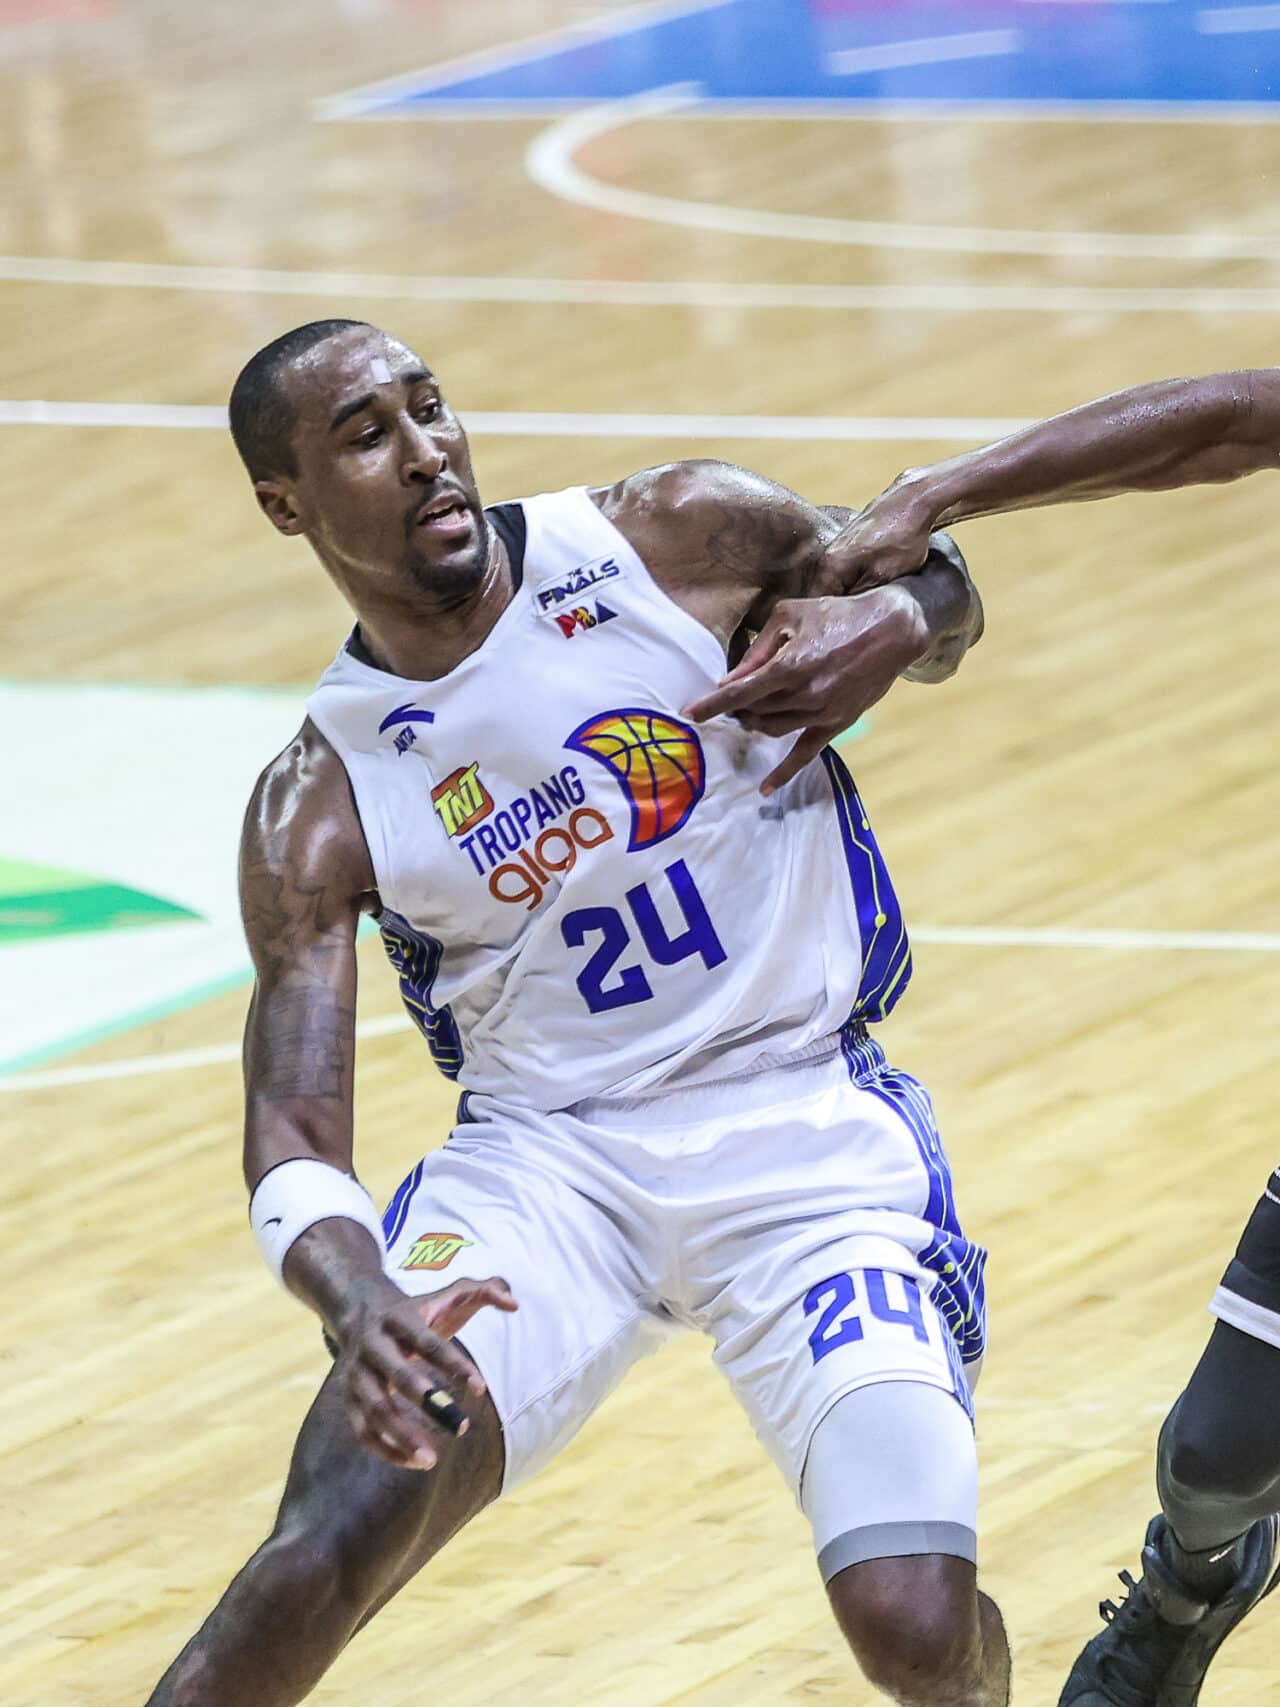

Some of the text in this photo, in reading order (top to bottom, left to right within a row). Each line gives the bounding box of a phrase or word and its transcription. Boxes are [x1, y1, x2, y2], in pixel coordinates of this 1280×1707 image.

[537, 558, 620, 611] FINALS
[554, 597, 619, 639] PBA
[433, 761, 486, 839] TNT
[458, 765, 586, 877] TROPANG
[560, 858, 728, 1015] 24
[399, 1238, 475, 1270] TNT
[802, 1268, 931, 1367] 24
